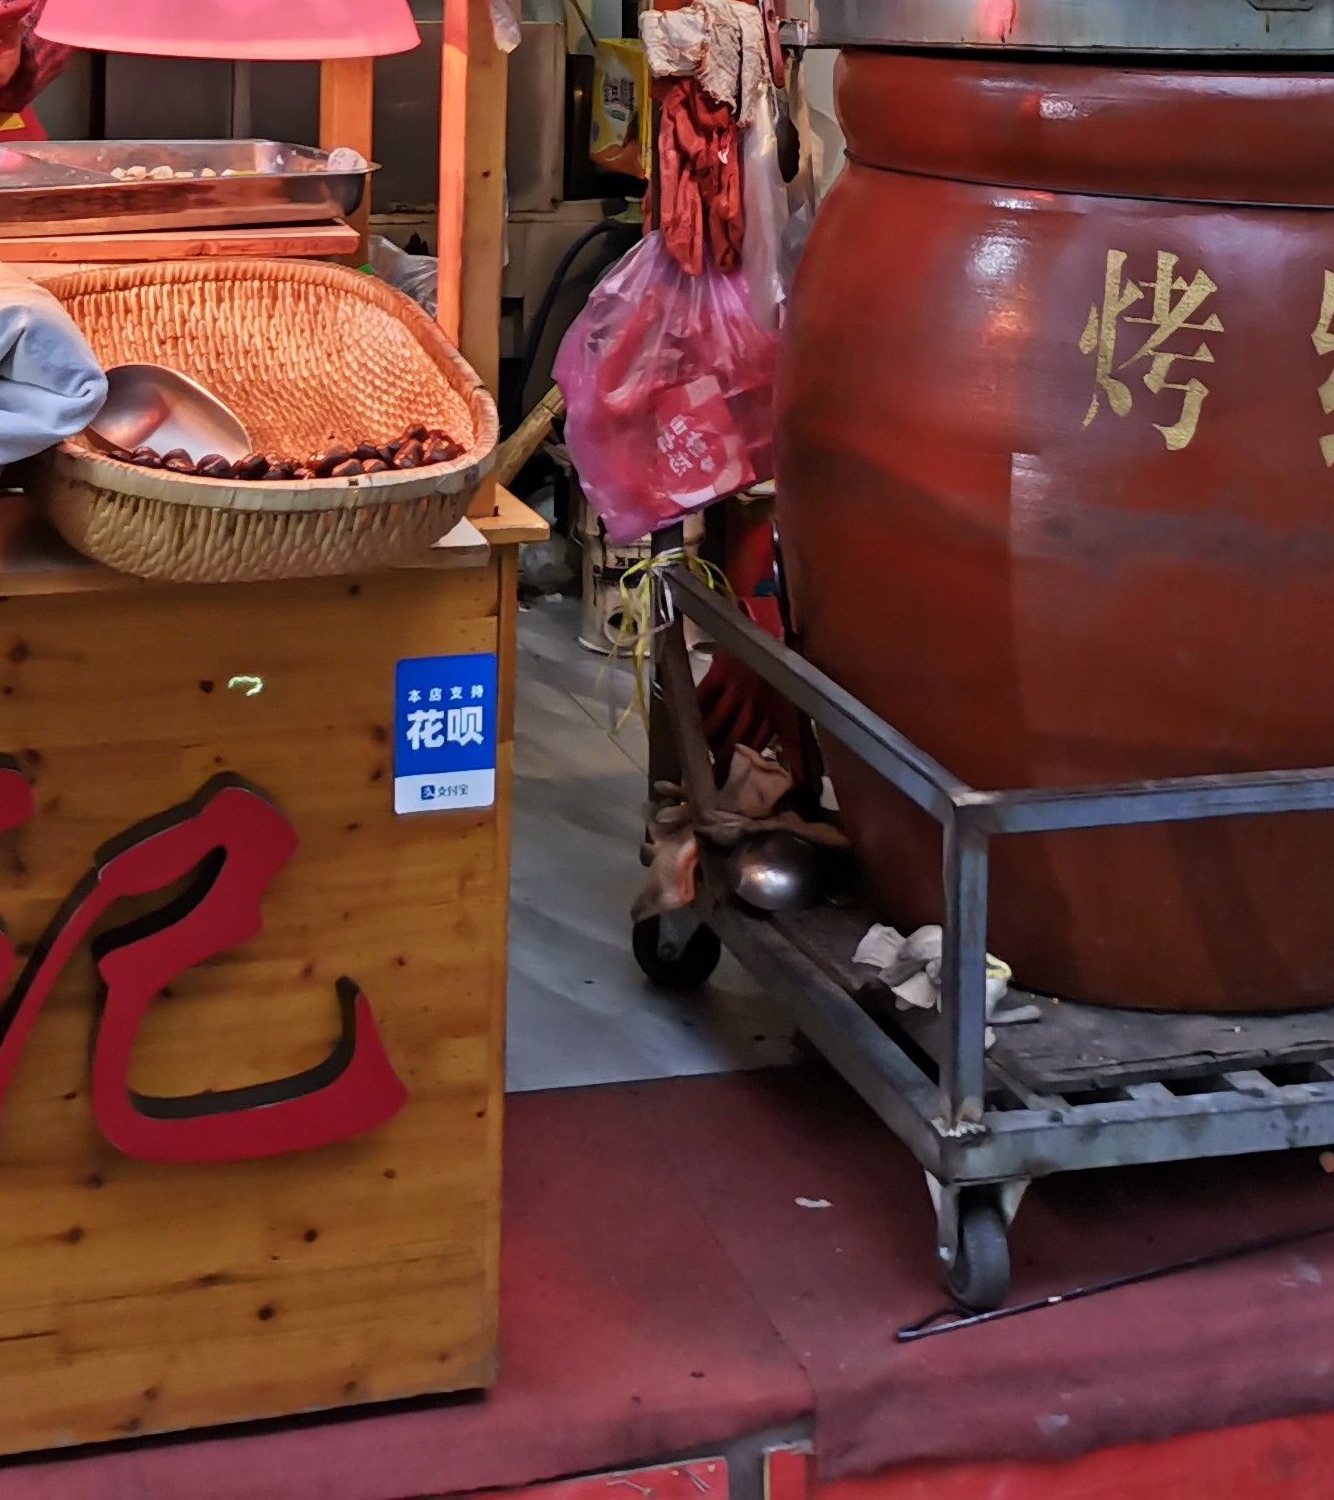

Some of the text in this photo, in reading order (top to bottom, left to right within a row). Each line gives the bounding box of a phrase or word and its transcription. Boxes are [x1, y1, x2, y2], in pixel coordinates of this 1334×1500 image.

[407, 684, 484, 703] 本店支持
[406, 705, 485, 751] 花呗
[437, 784, 469, 797] 支付宝
